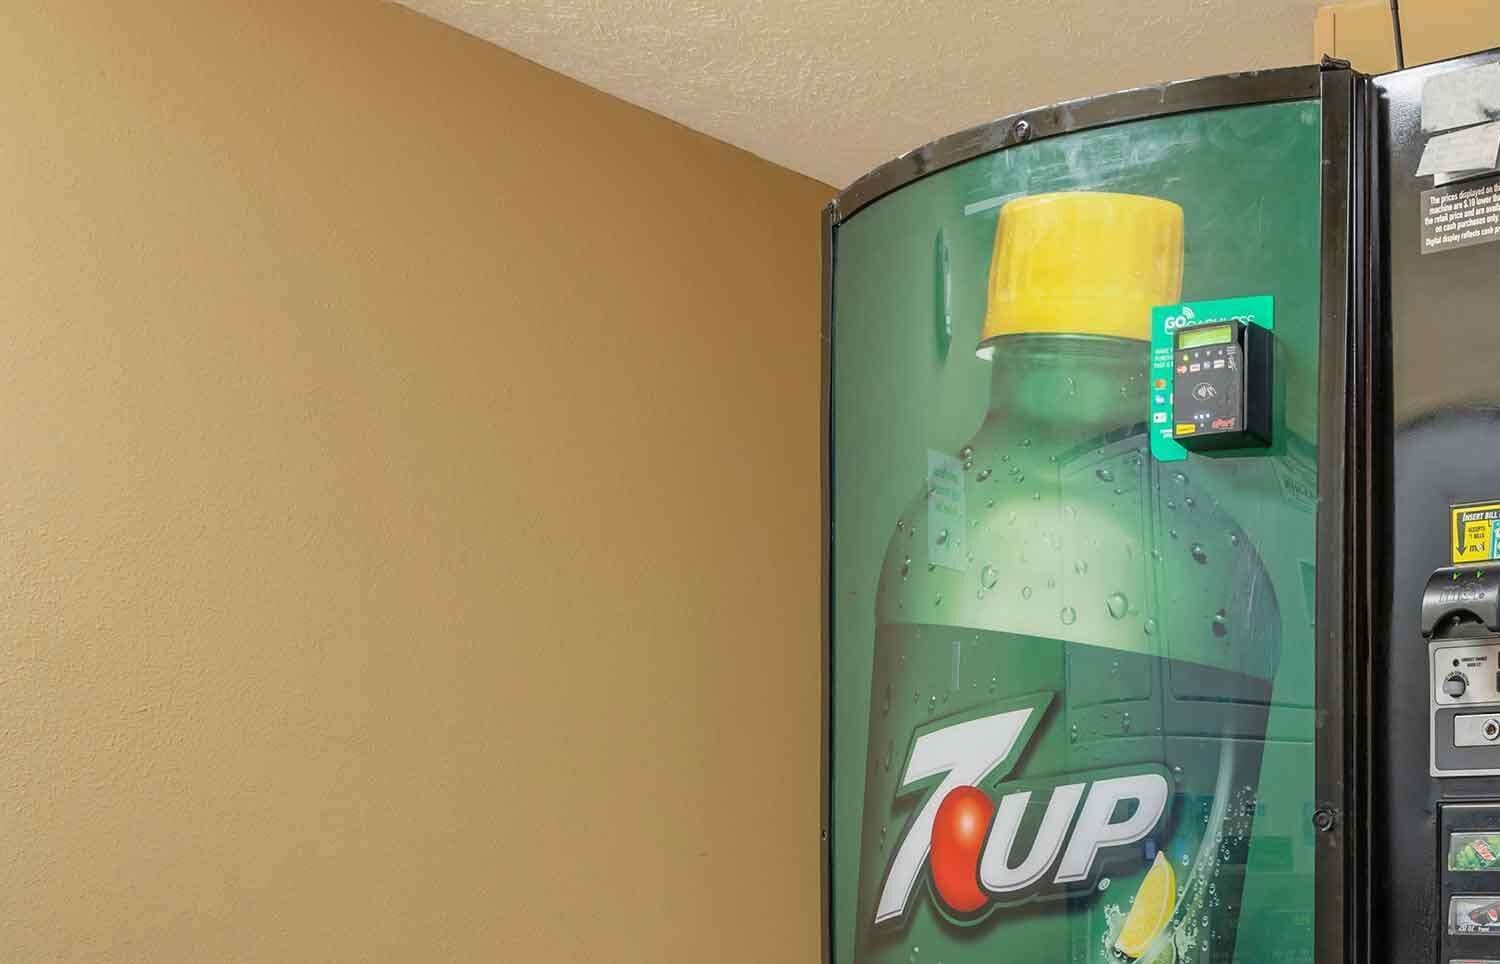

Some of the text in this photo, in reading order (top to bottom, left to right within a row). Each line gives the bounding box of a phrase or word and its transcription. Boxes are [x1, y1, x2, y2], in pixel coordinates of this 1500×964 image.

[1429, 204, 1453, 215] machine
[1476, 196, 1492, 205] lower
[1441, 193, 1458, 207] prices
[1459, 186, 1485, 199] displayed
[1425, 217, 1433, 225] the
[1434, 213, 1448, 223] retail
[1449, 212, 1463, 223] price
[1464, 209, 1475, 218] and
[1476, 207, 1485, 215] are
[1443, 222, 1457, 231] cash
[1457, 217, 1486, 231] purchases
[1443, 233, 1460, 242] display
[1461, 230, 1480, 239] reflects
[1481, 226, 1493, 235] cash
[1463, 512, 1484, 522] INSERT
[1485, 510, 1497, 519] BILL
[875, 707, 1168, 924] 7UP
